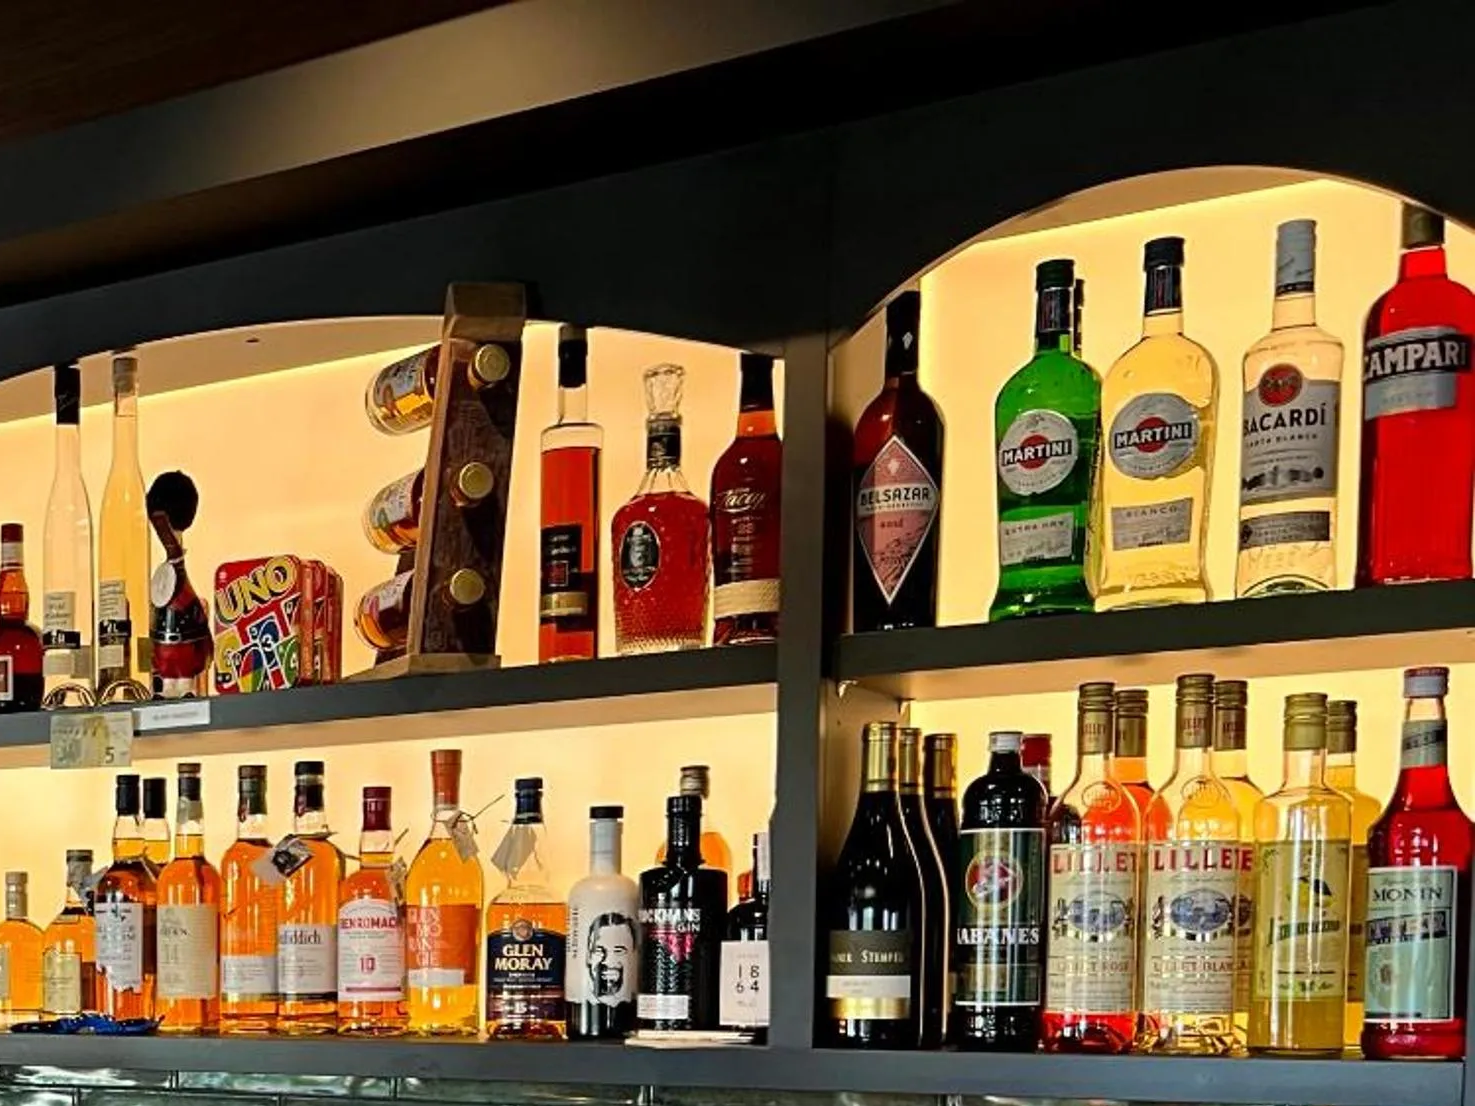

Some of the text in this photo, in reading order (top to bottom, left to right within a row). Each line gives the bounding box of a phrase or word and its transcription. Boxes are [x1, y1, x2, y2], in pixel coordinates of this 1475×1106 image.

[1363, 340, 1468, 381] AMPARI
[1116, 424, 1189, 448] MARTINI
[1003, 443, 1070, 466] MARTINI
[860, 487, 930, 506] BELSAZAR
[1126, 506, 1178, 518] BIANCO
[216, 557, 297, 624] UNO
[105, 746, 115, 764] 5
[1373, 886, 1443, 901] MONIN
[677, 924, 701, 933] GIN
[502, 943, 544, 957] GLEN
[494, 957, 553, 971] MORAY
